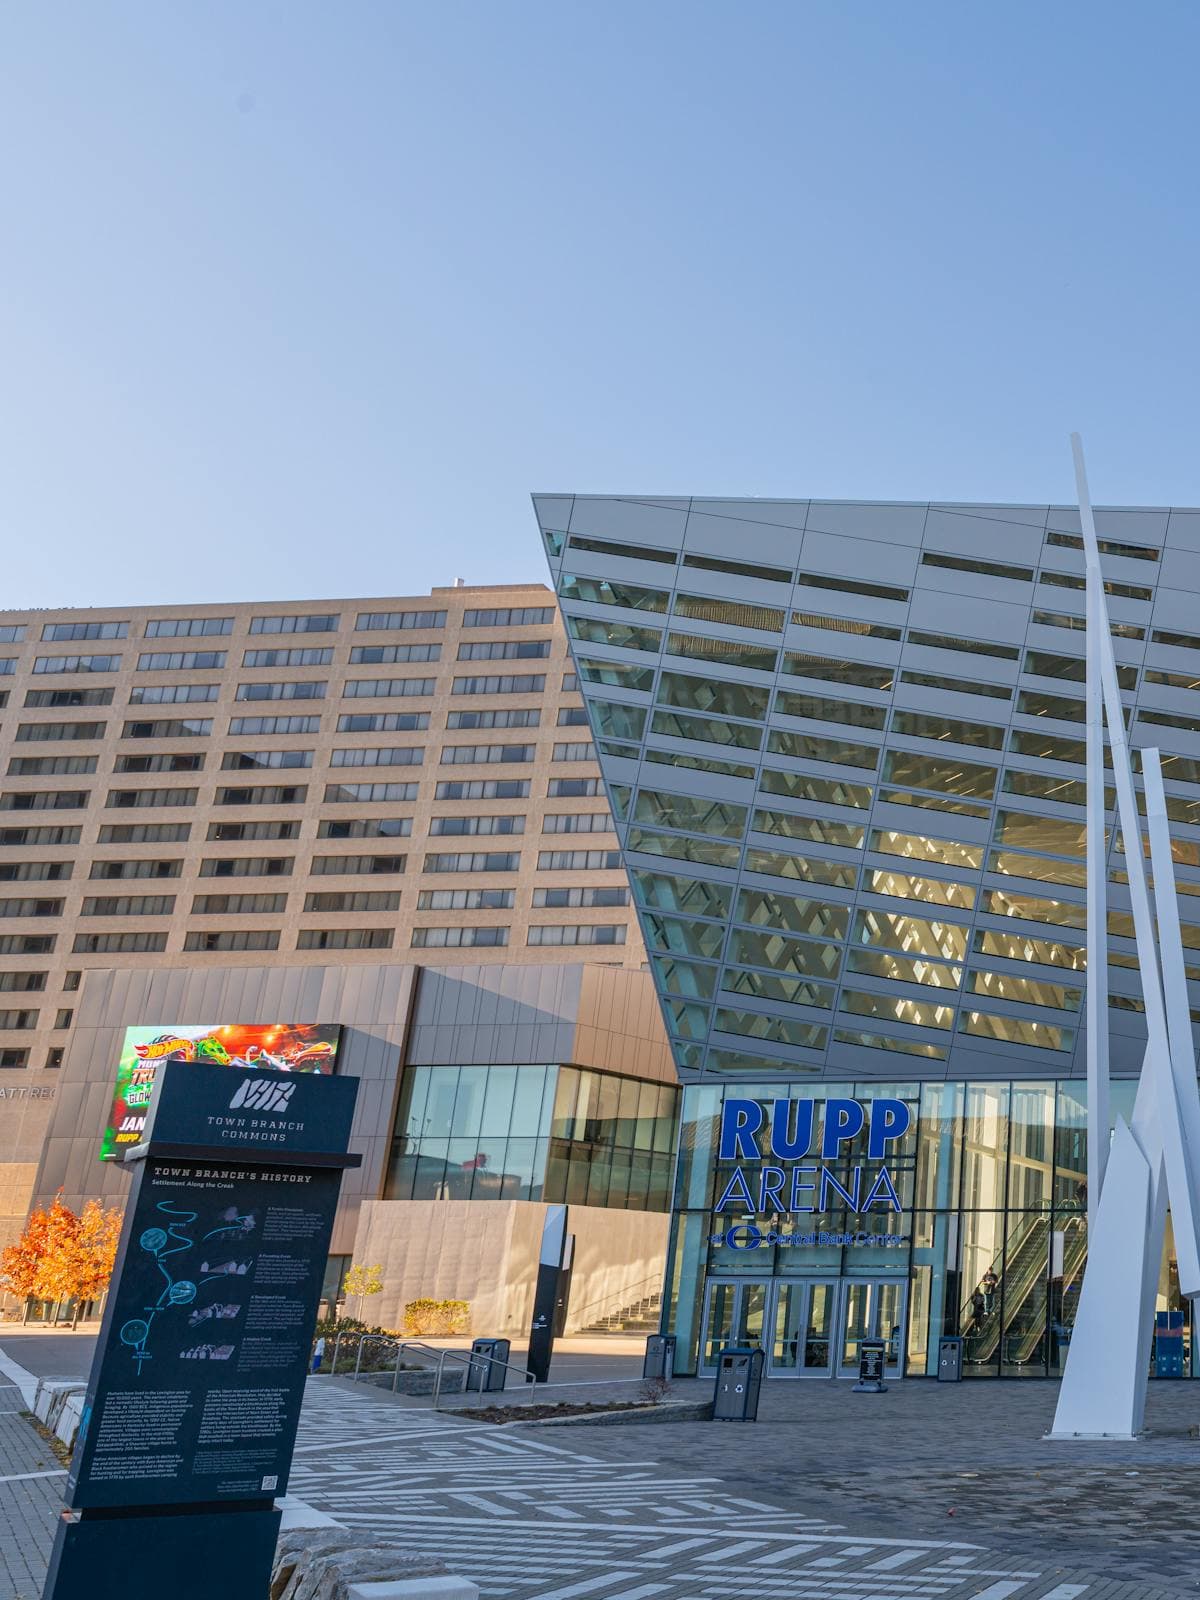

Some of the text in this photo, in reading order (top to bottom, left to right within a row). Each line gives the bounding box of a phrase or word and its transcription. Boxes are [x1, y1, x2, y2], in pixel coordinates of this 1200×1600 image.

[119, 1116, 146, 1131] JAN
[207, 1116, 305, 1131] TOWN BRANCH
[719, 1098, 910, 1160] RUPP
[221, 1130, 287, 1142] COMMONS
[154, 1167, 313, 1184] TOWN BRANCH'S HISTORY
[714, 1165, 903, 1214] ARENA
[766, 1232, 816, 1246] Central
[818, 1232, 853, 1245] Bank
[856, 1232, 904, 1245] Center
